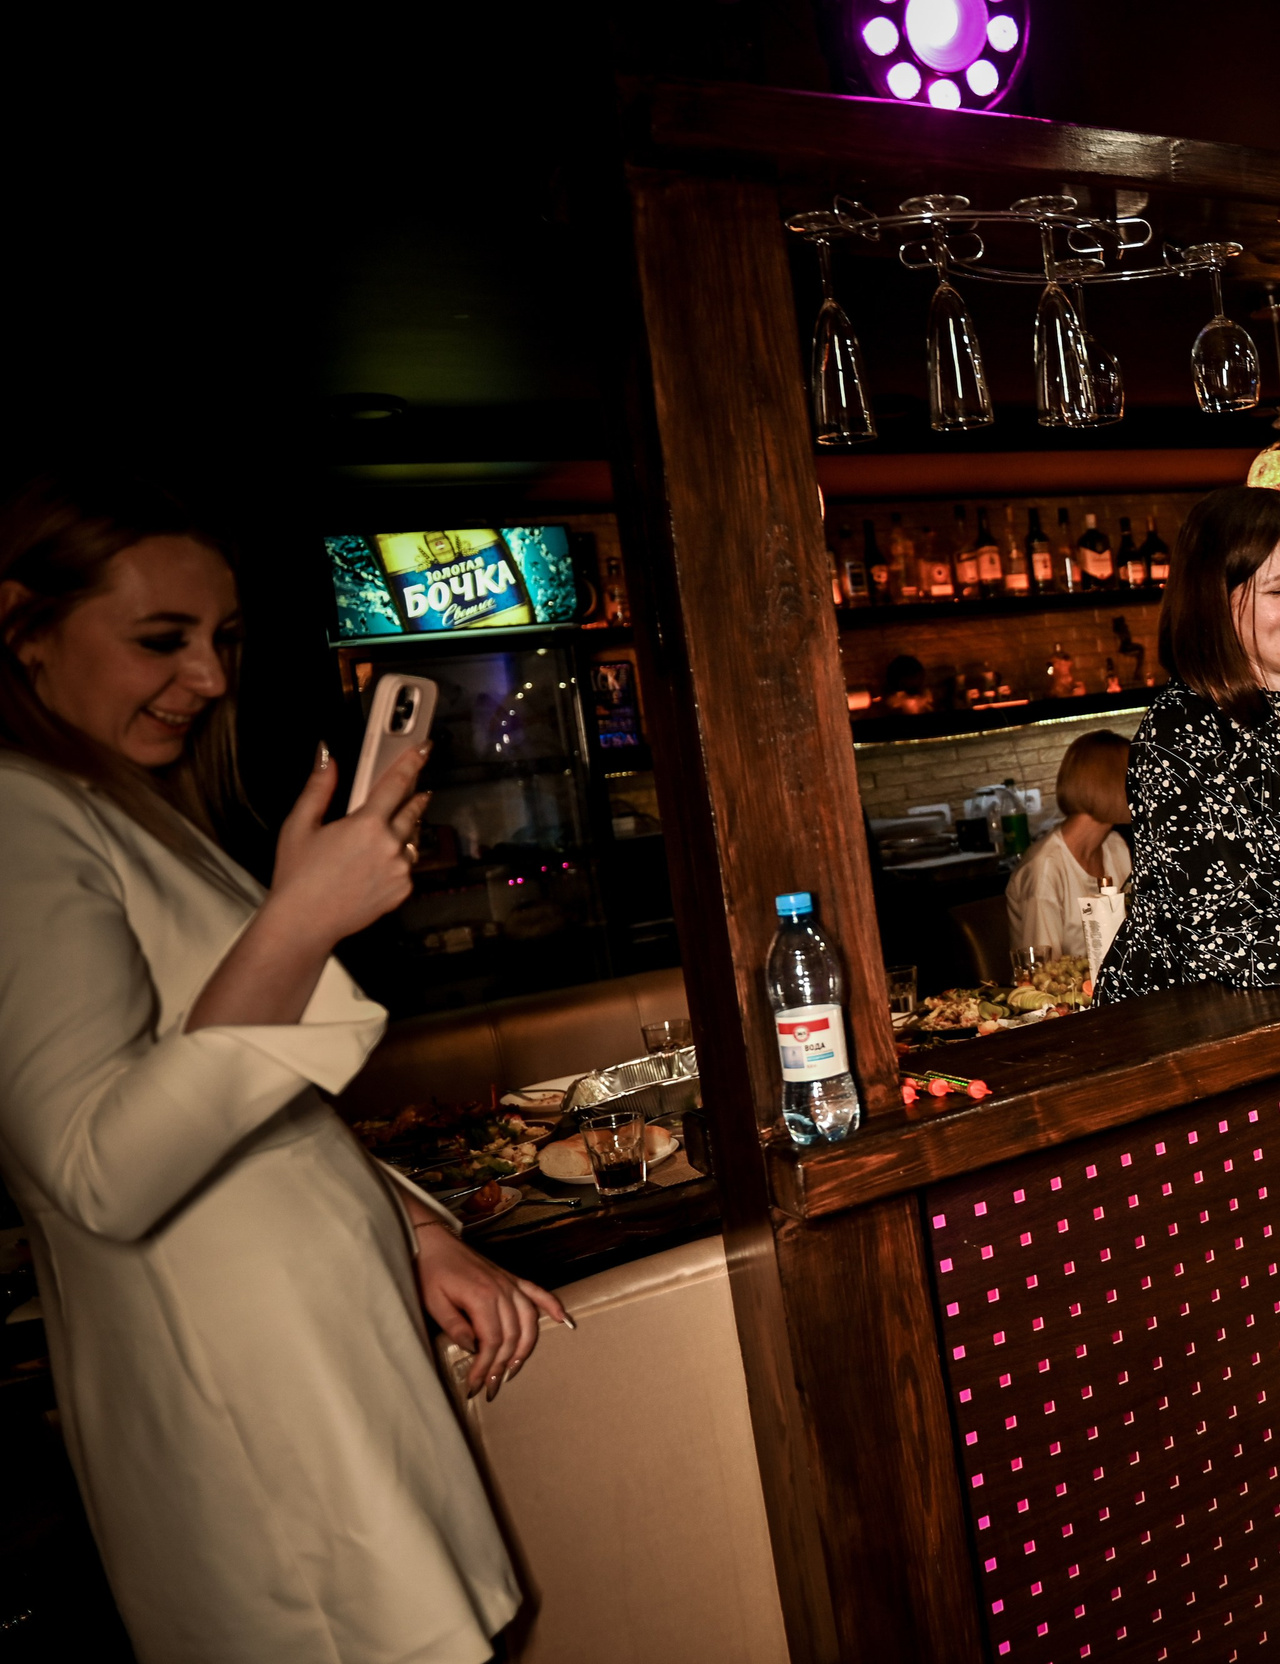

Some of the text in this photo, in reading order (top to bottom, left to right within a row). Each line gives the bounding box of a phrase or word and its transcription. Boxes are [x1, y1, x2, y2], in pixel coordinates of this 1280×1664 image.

[426, 557, 484, 585] ЗОЛОТАЯ
[403, 559, 517, 618] БОЧКА
[805, 1043, 825, 1051] ВОДА
